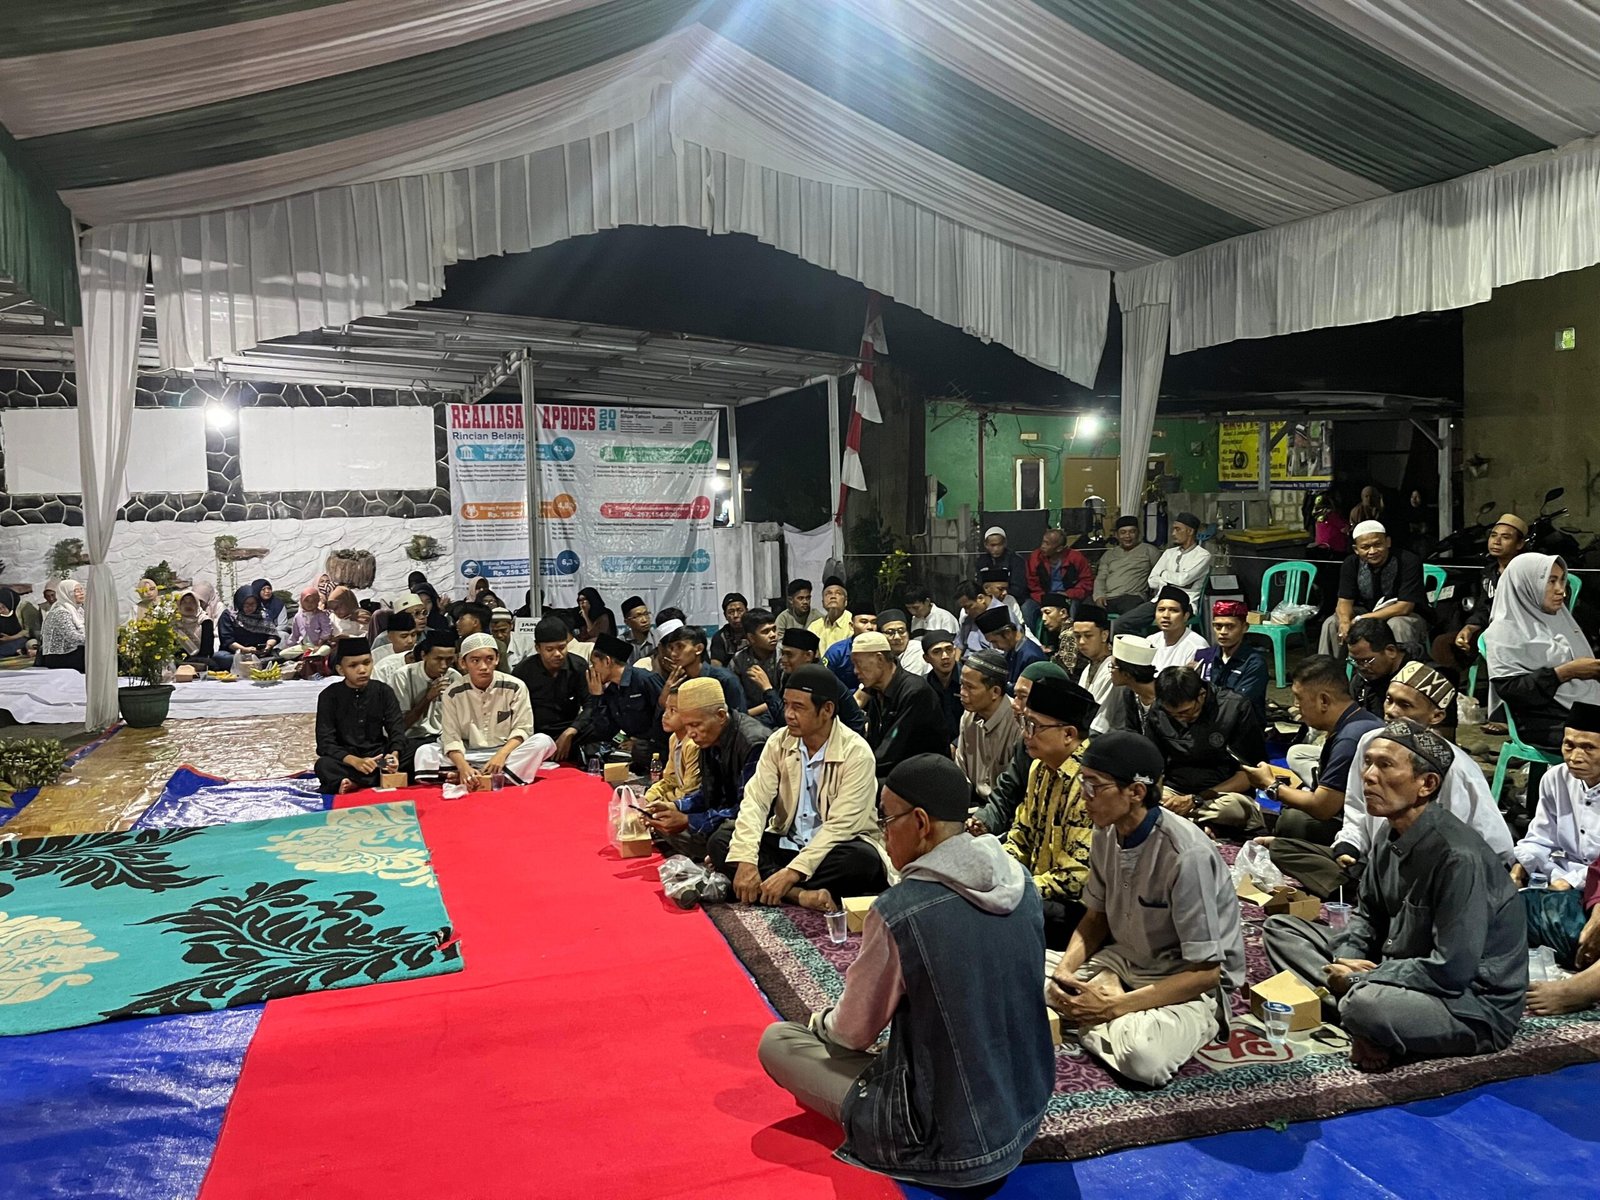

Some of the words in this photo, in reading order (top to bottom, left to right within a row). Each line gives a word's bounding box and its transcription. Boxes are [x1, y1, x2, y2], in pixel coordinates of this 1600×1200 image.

[451, 405, 537, 429] REALIASA
[542, 406, 596, 431] APBDES
[599, 409, 616, 420] 20
[599, 420, 616, 431] 24
[452, 431, 489, 440] Rincian
